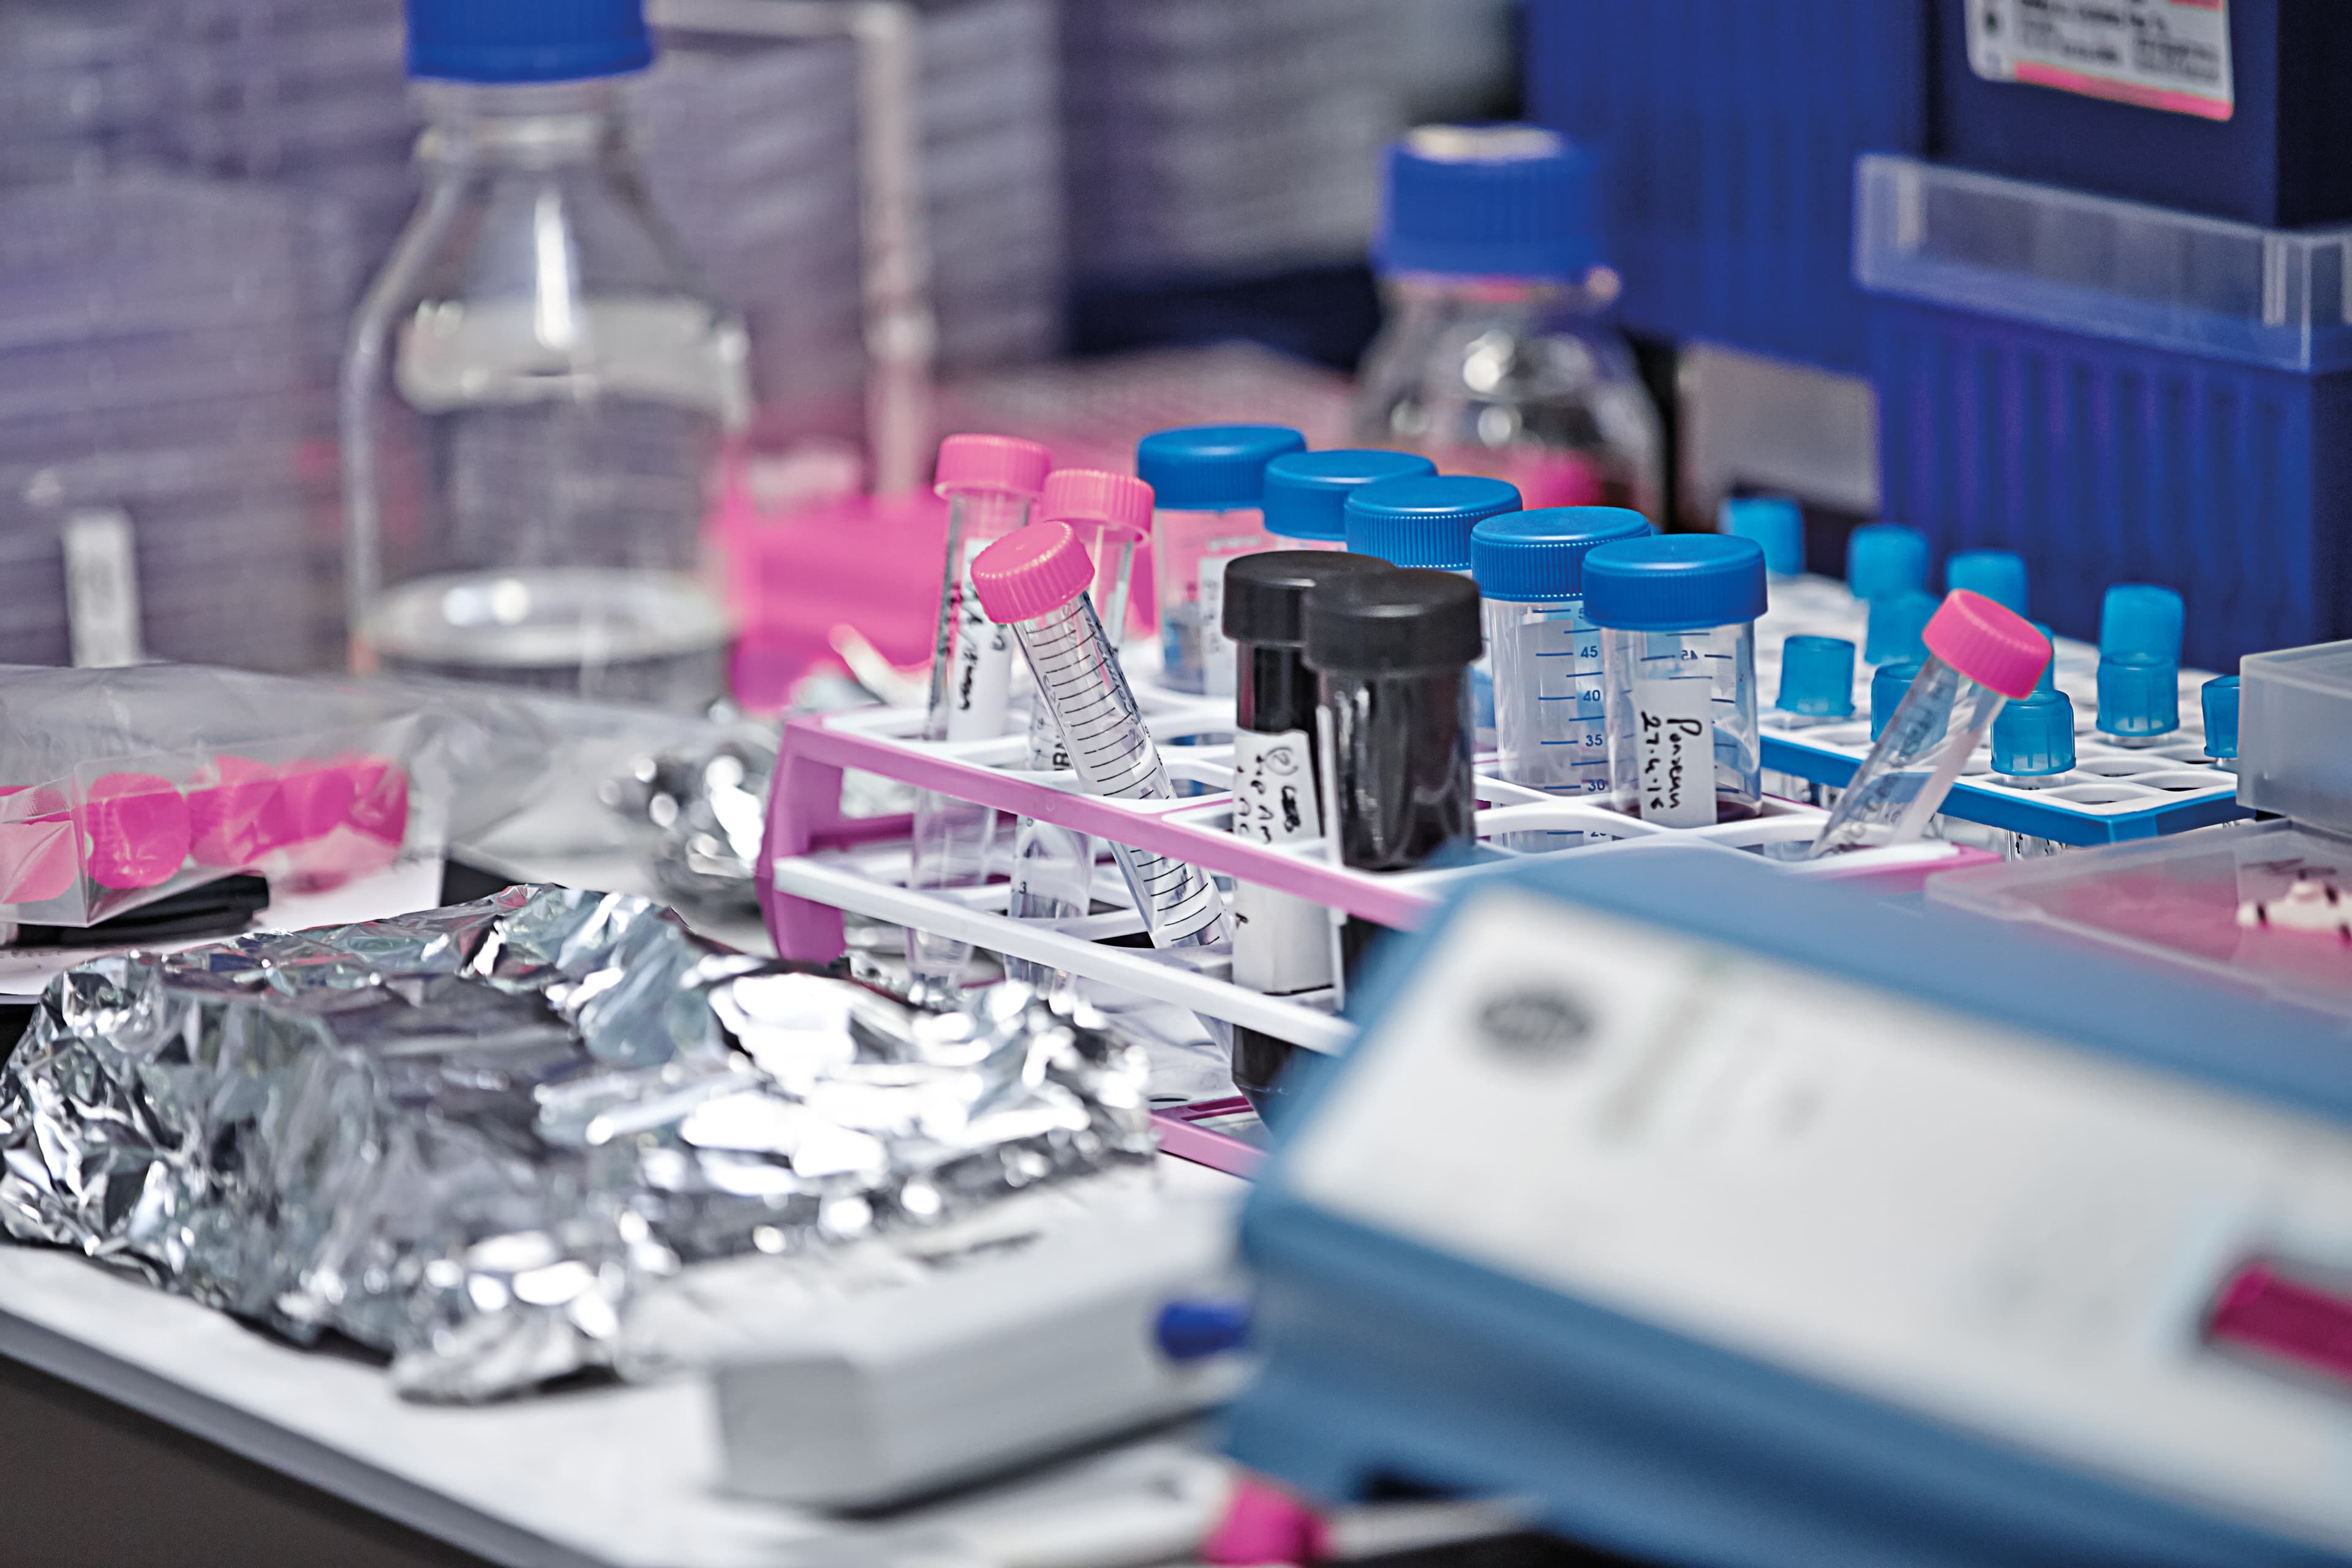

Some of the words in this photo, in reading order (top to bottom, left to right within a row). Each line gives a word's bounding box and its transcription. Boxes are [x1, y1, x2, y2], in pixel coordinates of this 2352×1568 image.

[1580, 645, 1599, 658] 45
[1583, 690, 1601, 702] 40
[1585, 734, 1604, 747] 35
[1588, 778, 1606, 792] 30
[1019, 881, 1027, 894] 3
